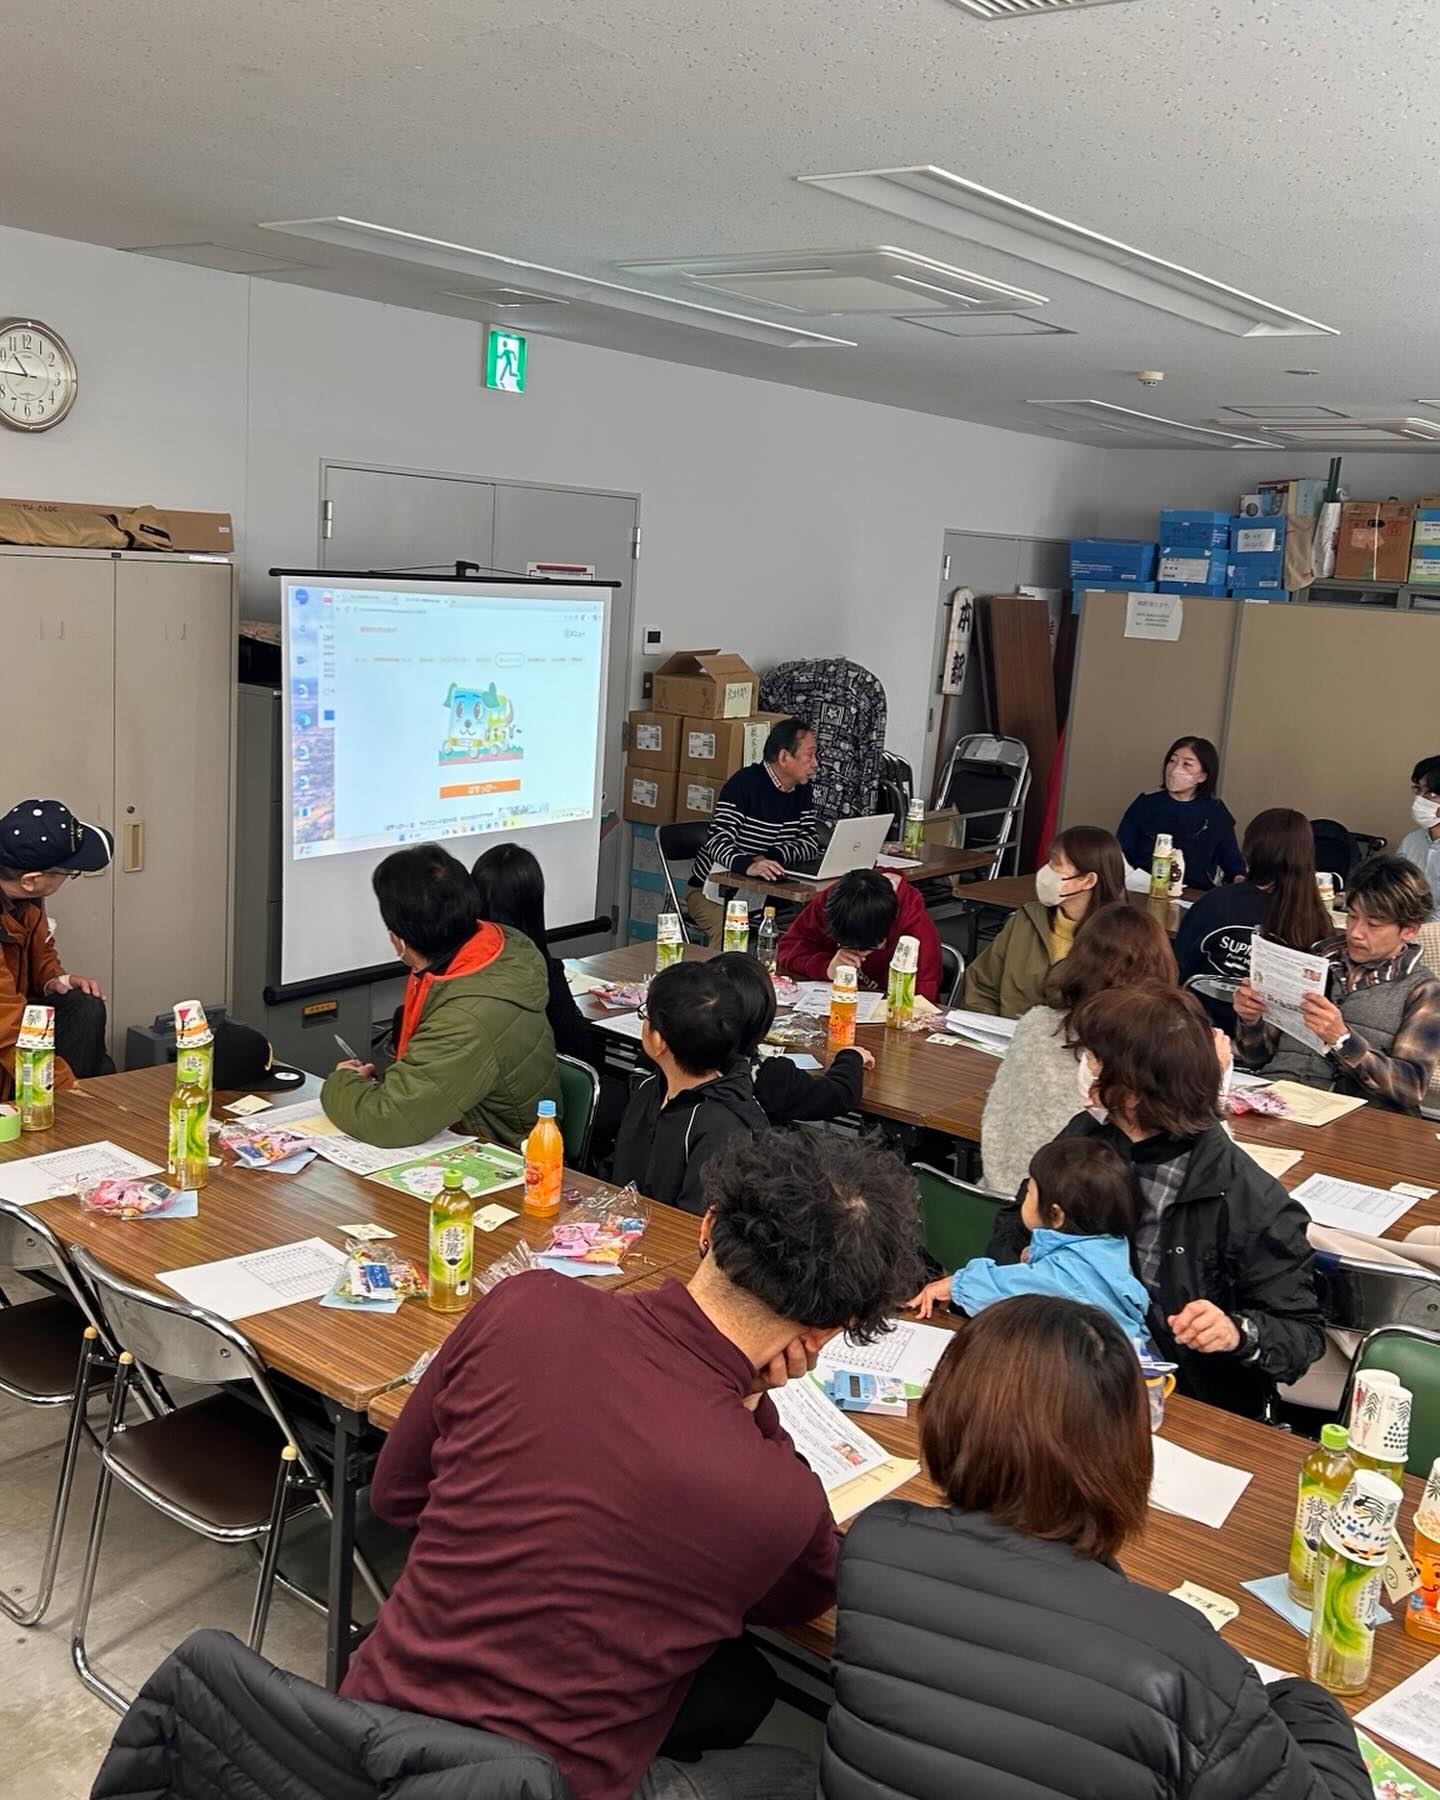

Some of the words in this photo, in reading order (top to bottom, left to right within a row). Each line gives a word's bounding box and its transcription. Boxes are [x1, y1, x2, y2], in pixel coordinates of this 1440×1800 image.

[9, 336, 17, 352] 11
[23, 334, 32, 350] 12
[48, 352, 55, 367] 2
[54, 371, 61, 387] 3
[11, 396, 18, 412] 7
[48, 389, 55, 405] 4
[24, 402, 32, 418] 6
[38, 399, 45, 415] 5
[1219, 935, 1252, 956] SUP
